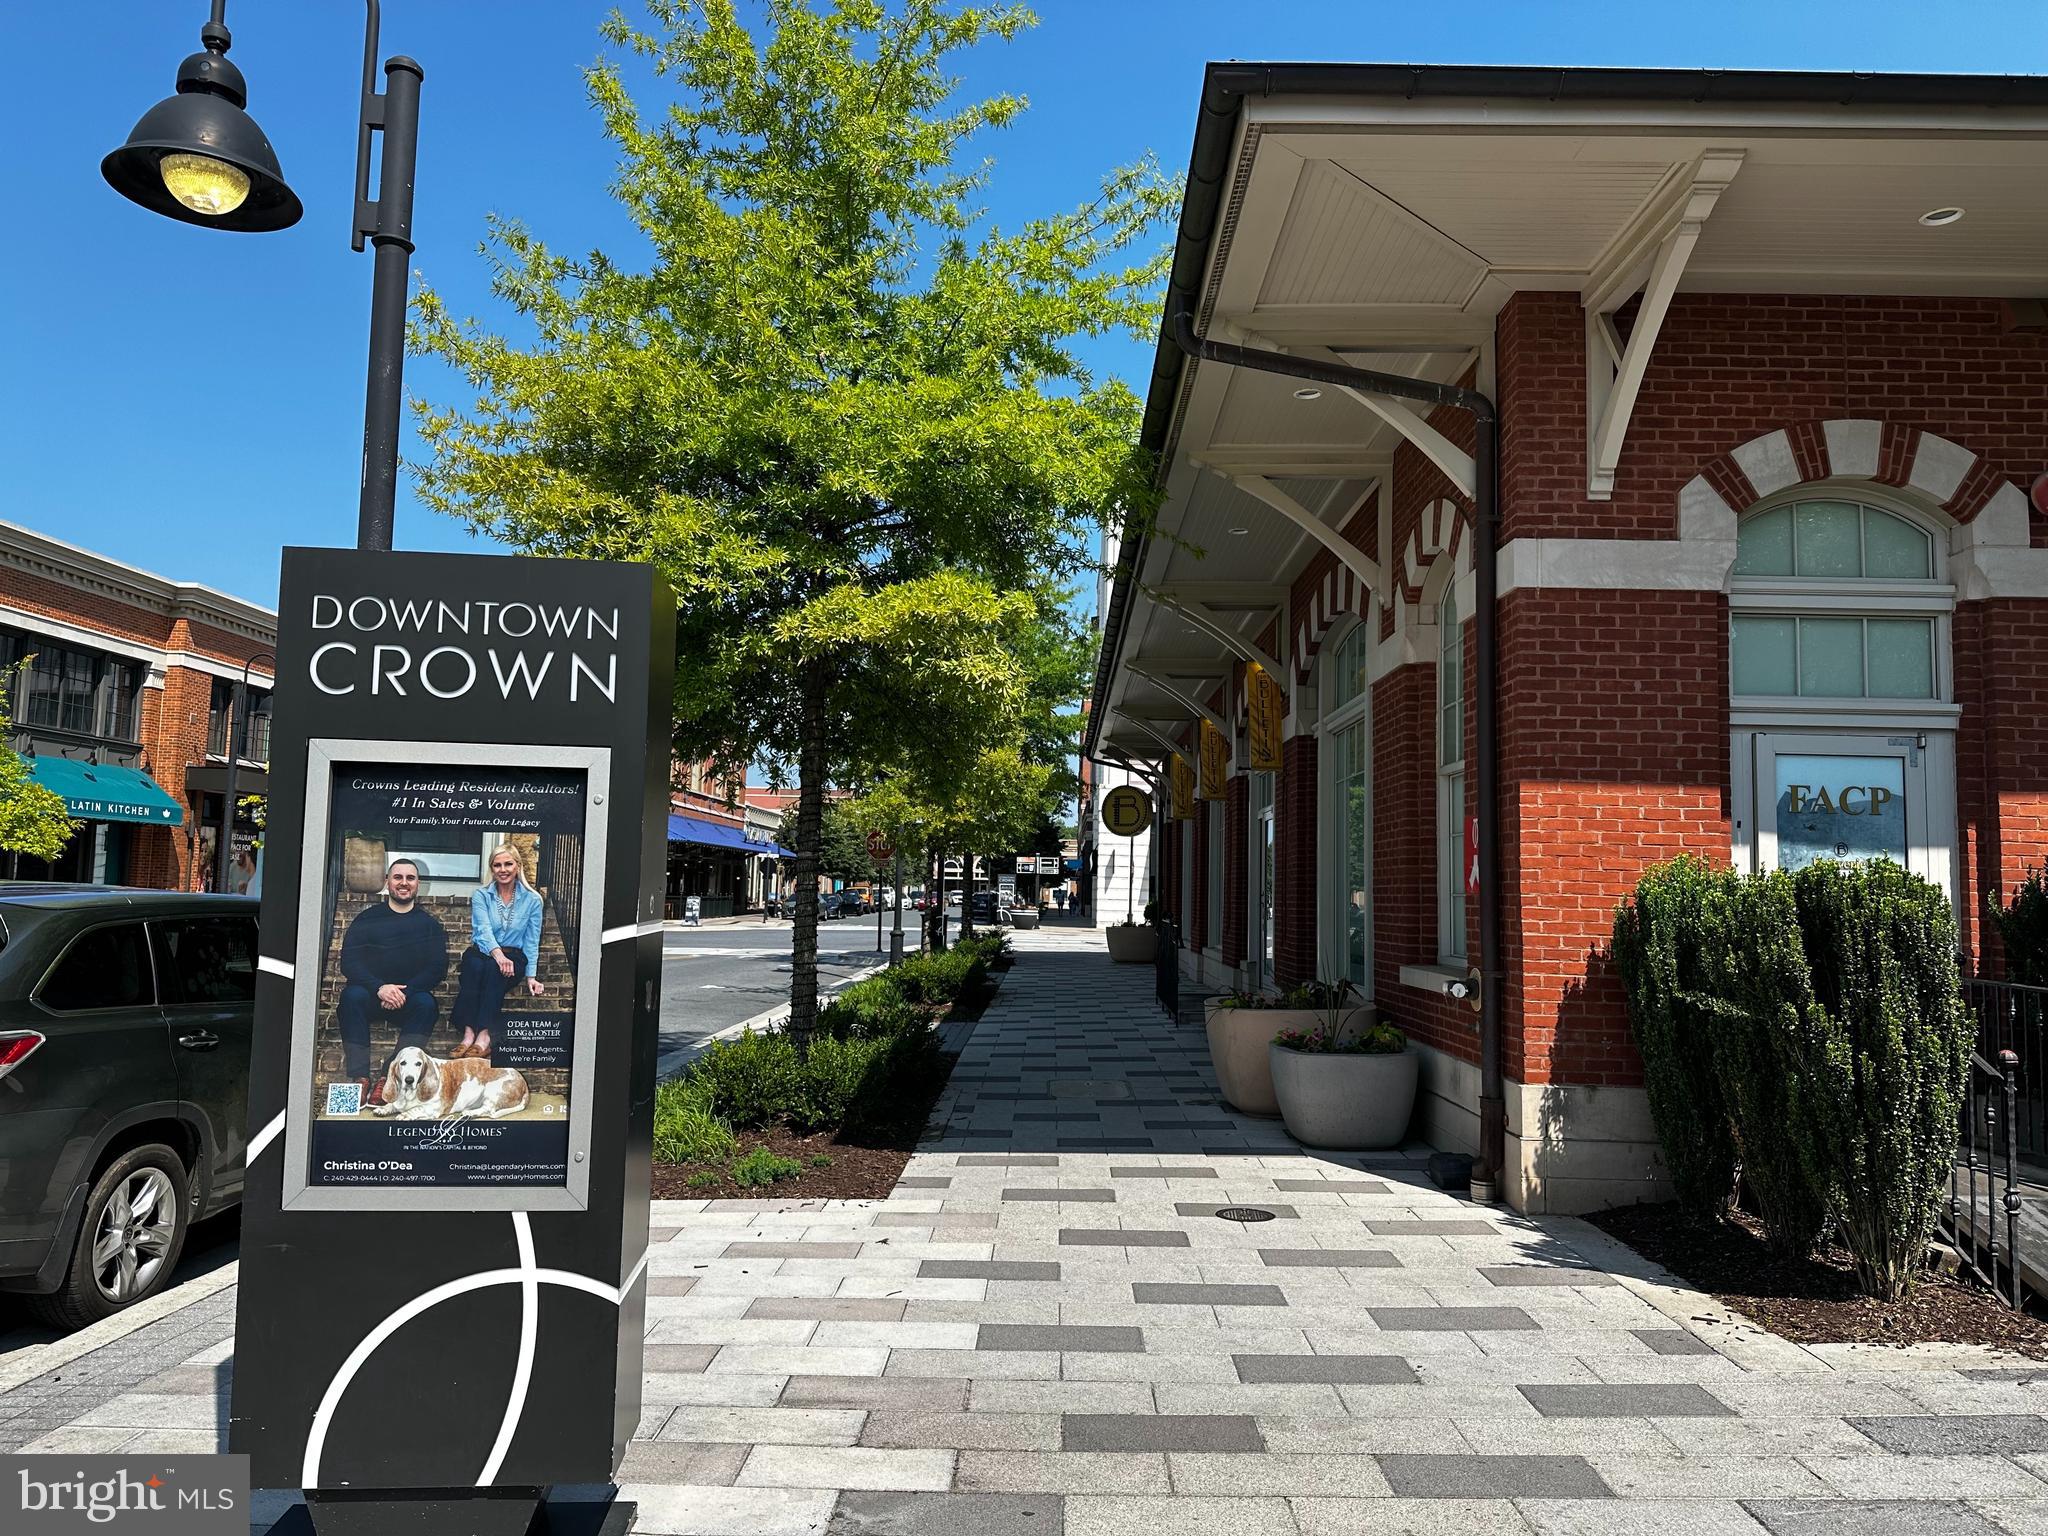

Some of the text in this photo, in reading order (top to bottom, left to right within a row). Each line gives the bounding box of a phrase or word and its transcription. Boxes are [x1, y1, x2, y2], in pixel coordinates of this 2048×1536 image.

[311, 594, 618, 641] DOWNTOWN
[309, 641, 617, 704] CROWN
[1259, 680, 1272, 760] BULLETIN
[352, 778, 580, 795] Crowns Leading Resident Realtors!
[391, 797, 535, 811] #1 In Sales & Volume
[1786, 784, 1892, 816] FACP
[71, 799, 150, 816] LATIN KITCHEN
[1112, 795, 1141, 827] B
[388, 816, 408, 824] Your
[511, 818, 540, 828] Legacy
[231, 833, 257, 841] ESTAURANT
[507, 1020, 530, 1028] O'DEA
[552, 1021, 560, 1029] of
[507, 1029, 528, 1037] LONG
[532, 1055, 557, 1063] Family
[323, 1160, 413, 1170] Christina O'Dea
[449, 1163, 566, 1171] Christina@LegendaryHomes.com
[467, 1173, 565, 1181] www.LegendaryHomes.com
